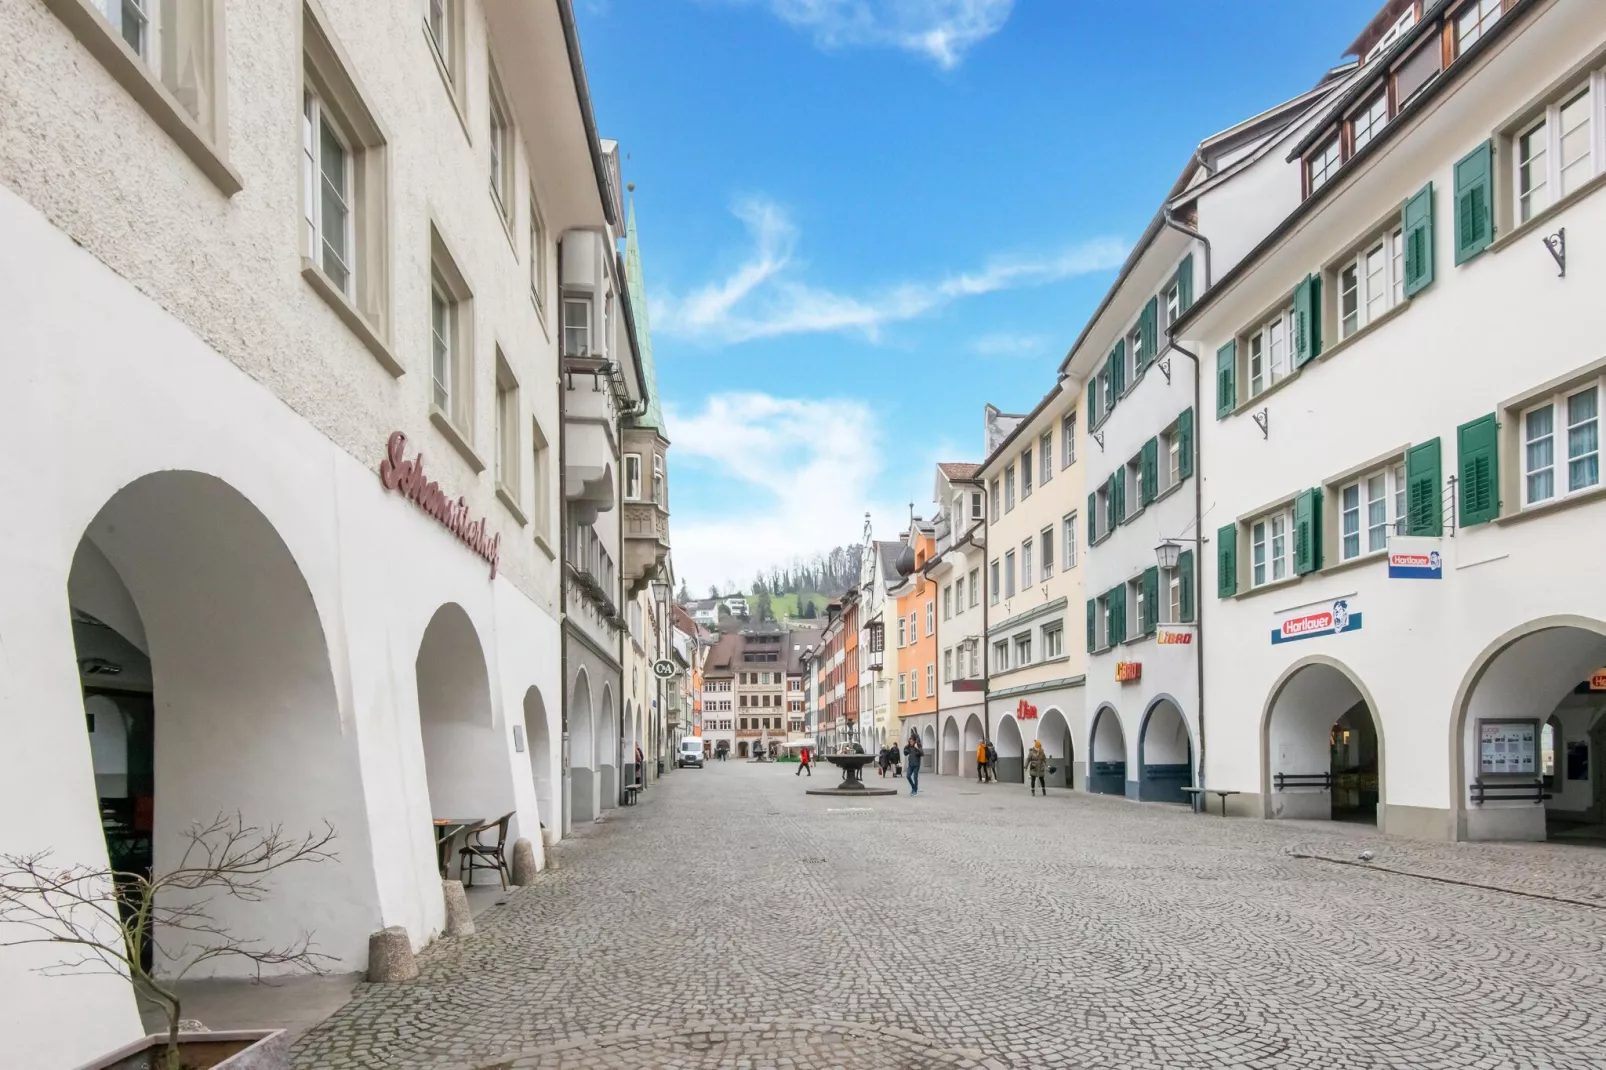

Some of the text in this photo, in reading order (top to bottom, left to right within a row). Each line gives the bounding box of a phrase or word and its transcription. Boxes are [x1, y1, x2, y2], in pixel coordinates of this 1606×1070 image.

[1394, 555, 1428, 565] Hartlauer
[1286, 615, 1330, 633] Hartlauer
[656, 663, 672, 674] C&A
